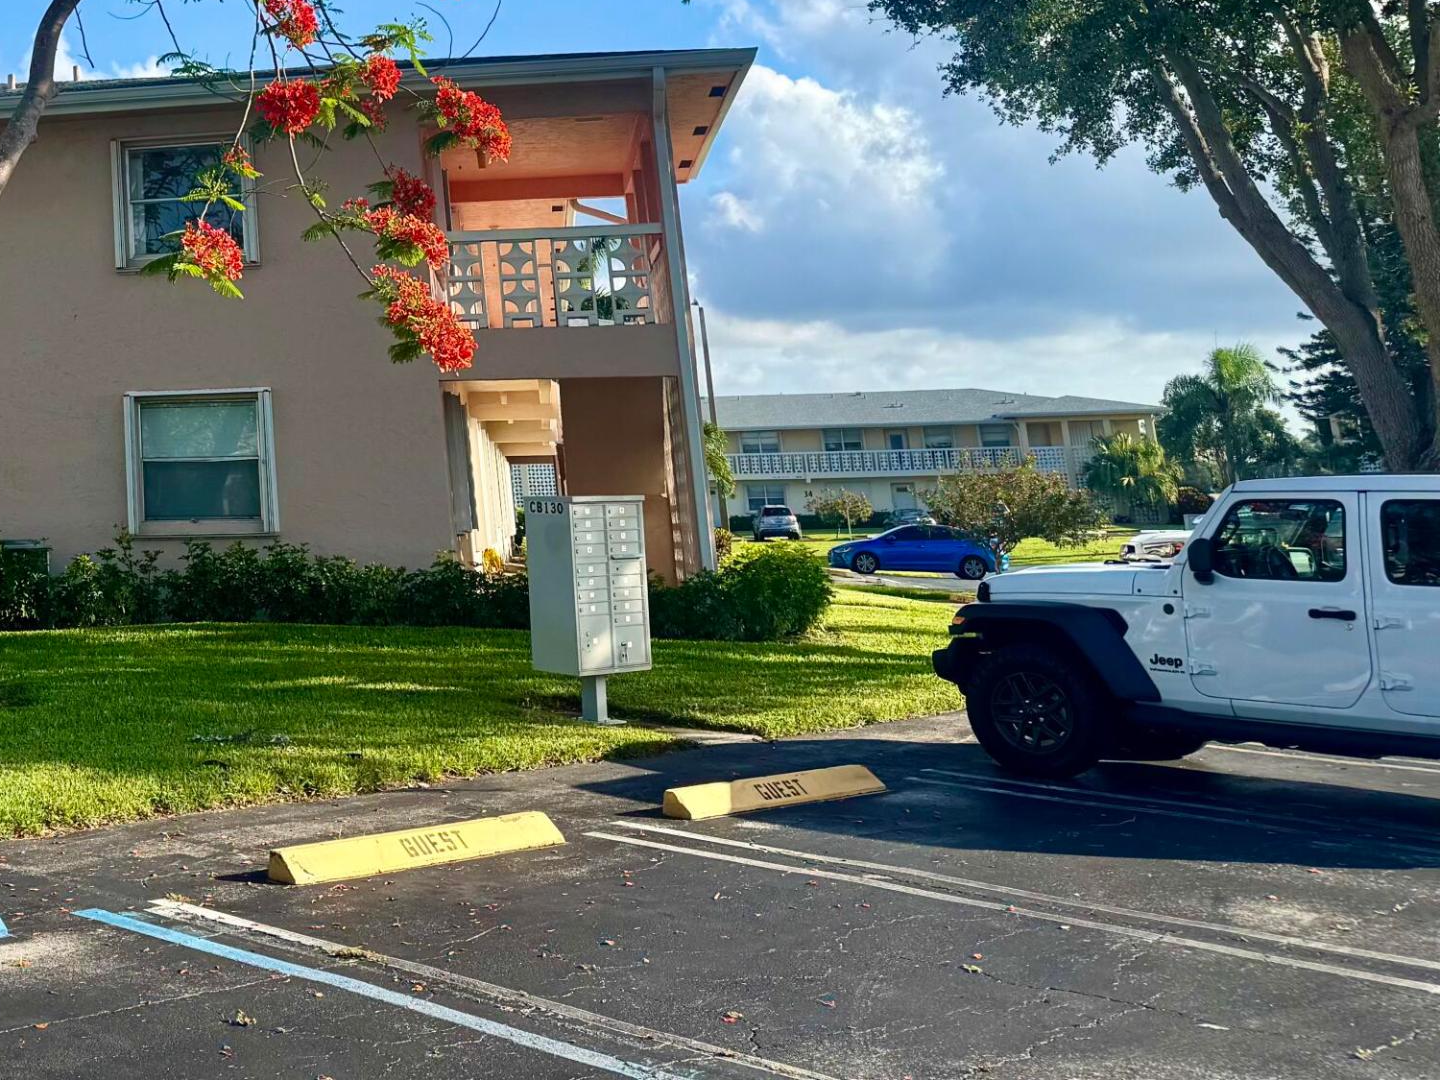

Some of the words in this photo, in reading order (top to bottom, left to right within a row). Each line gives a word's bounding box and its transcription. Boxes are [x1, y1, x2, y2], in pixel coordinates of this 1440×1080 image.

[529, 501, 564, 514] CB130
[1150, 653, 1183, 668] Jeep
[753, 779, 808, 800] GUEST
[399, 830, 468, 857] GUEST
